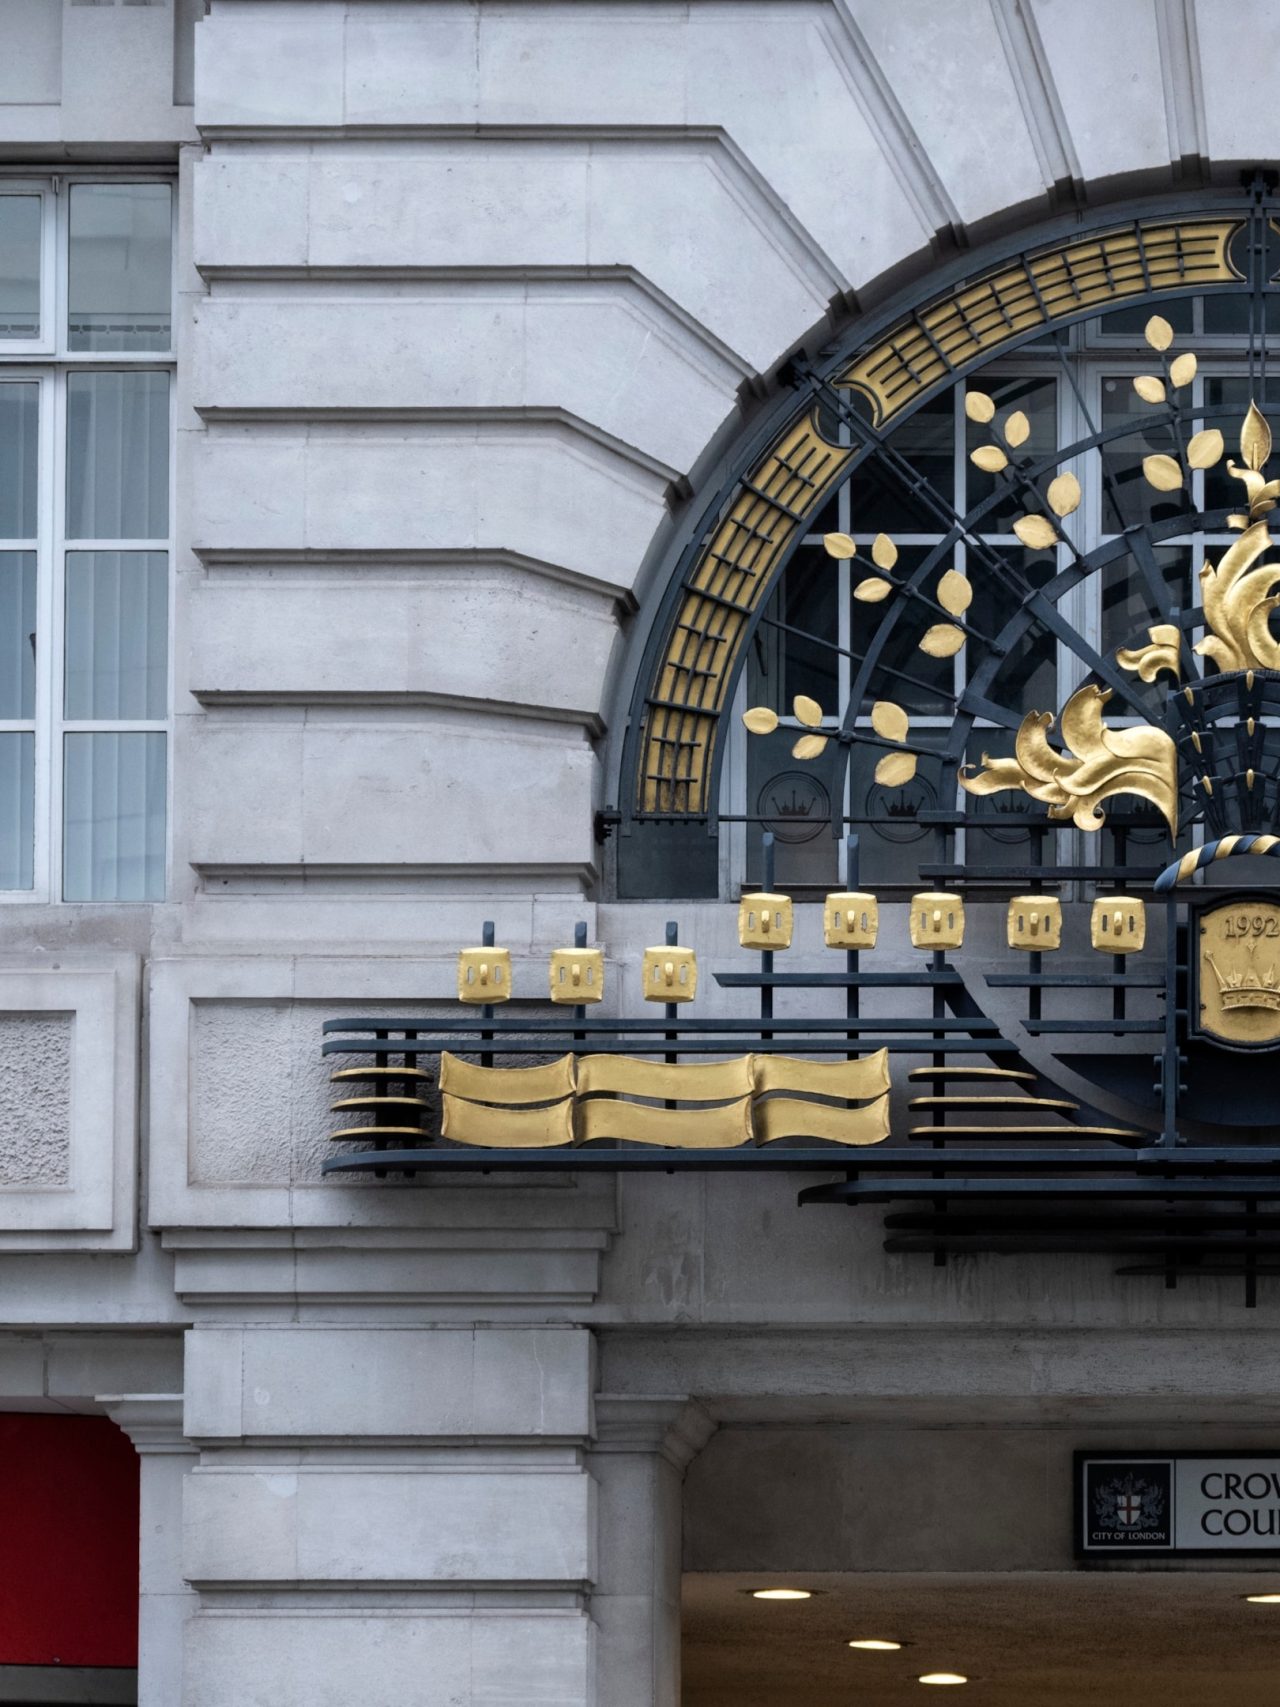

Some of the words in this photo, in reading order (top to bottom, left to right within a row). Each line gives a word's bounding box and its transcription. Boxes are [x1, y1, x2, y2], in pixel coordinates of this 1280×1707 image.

[1225, 915, 1280, 938] 1992
[1092, 1531, 1113, 1540] CITY
[1113, 1531, 1125, 1540] OF
[1128, 1531, 1166, 1540] LONDON
